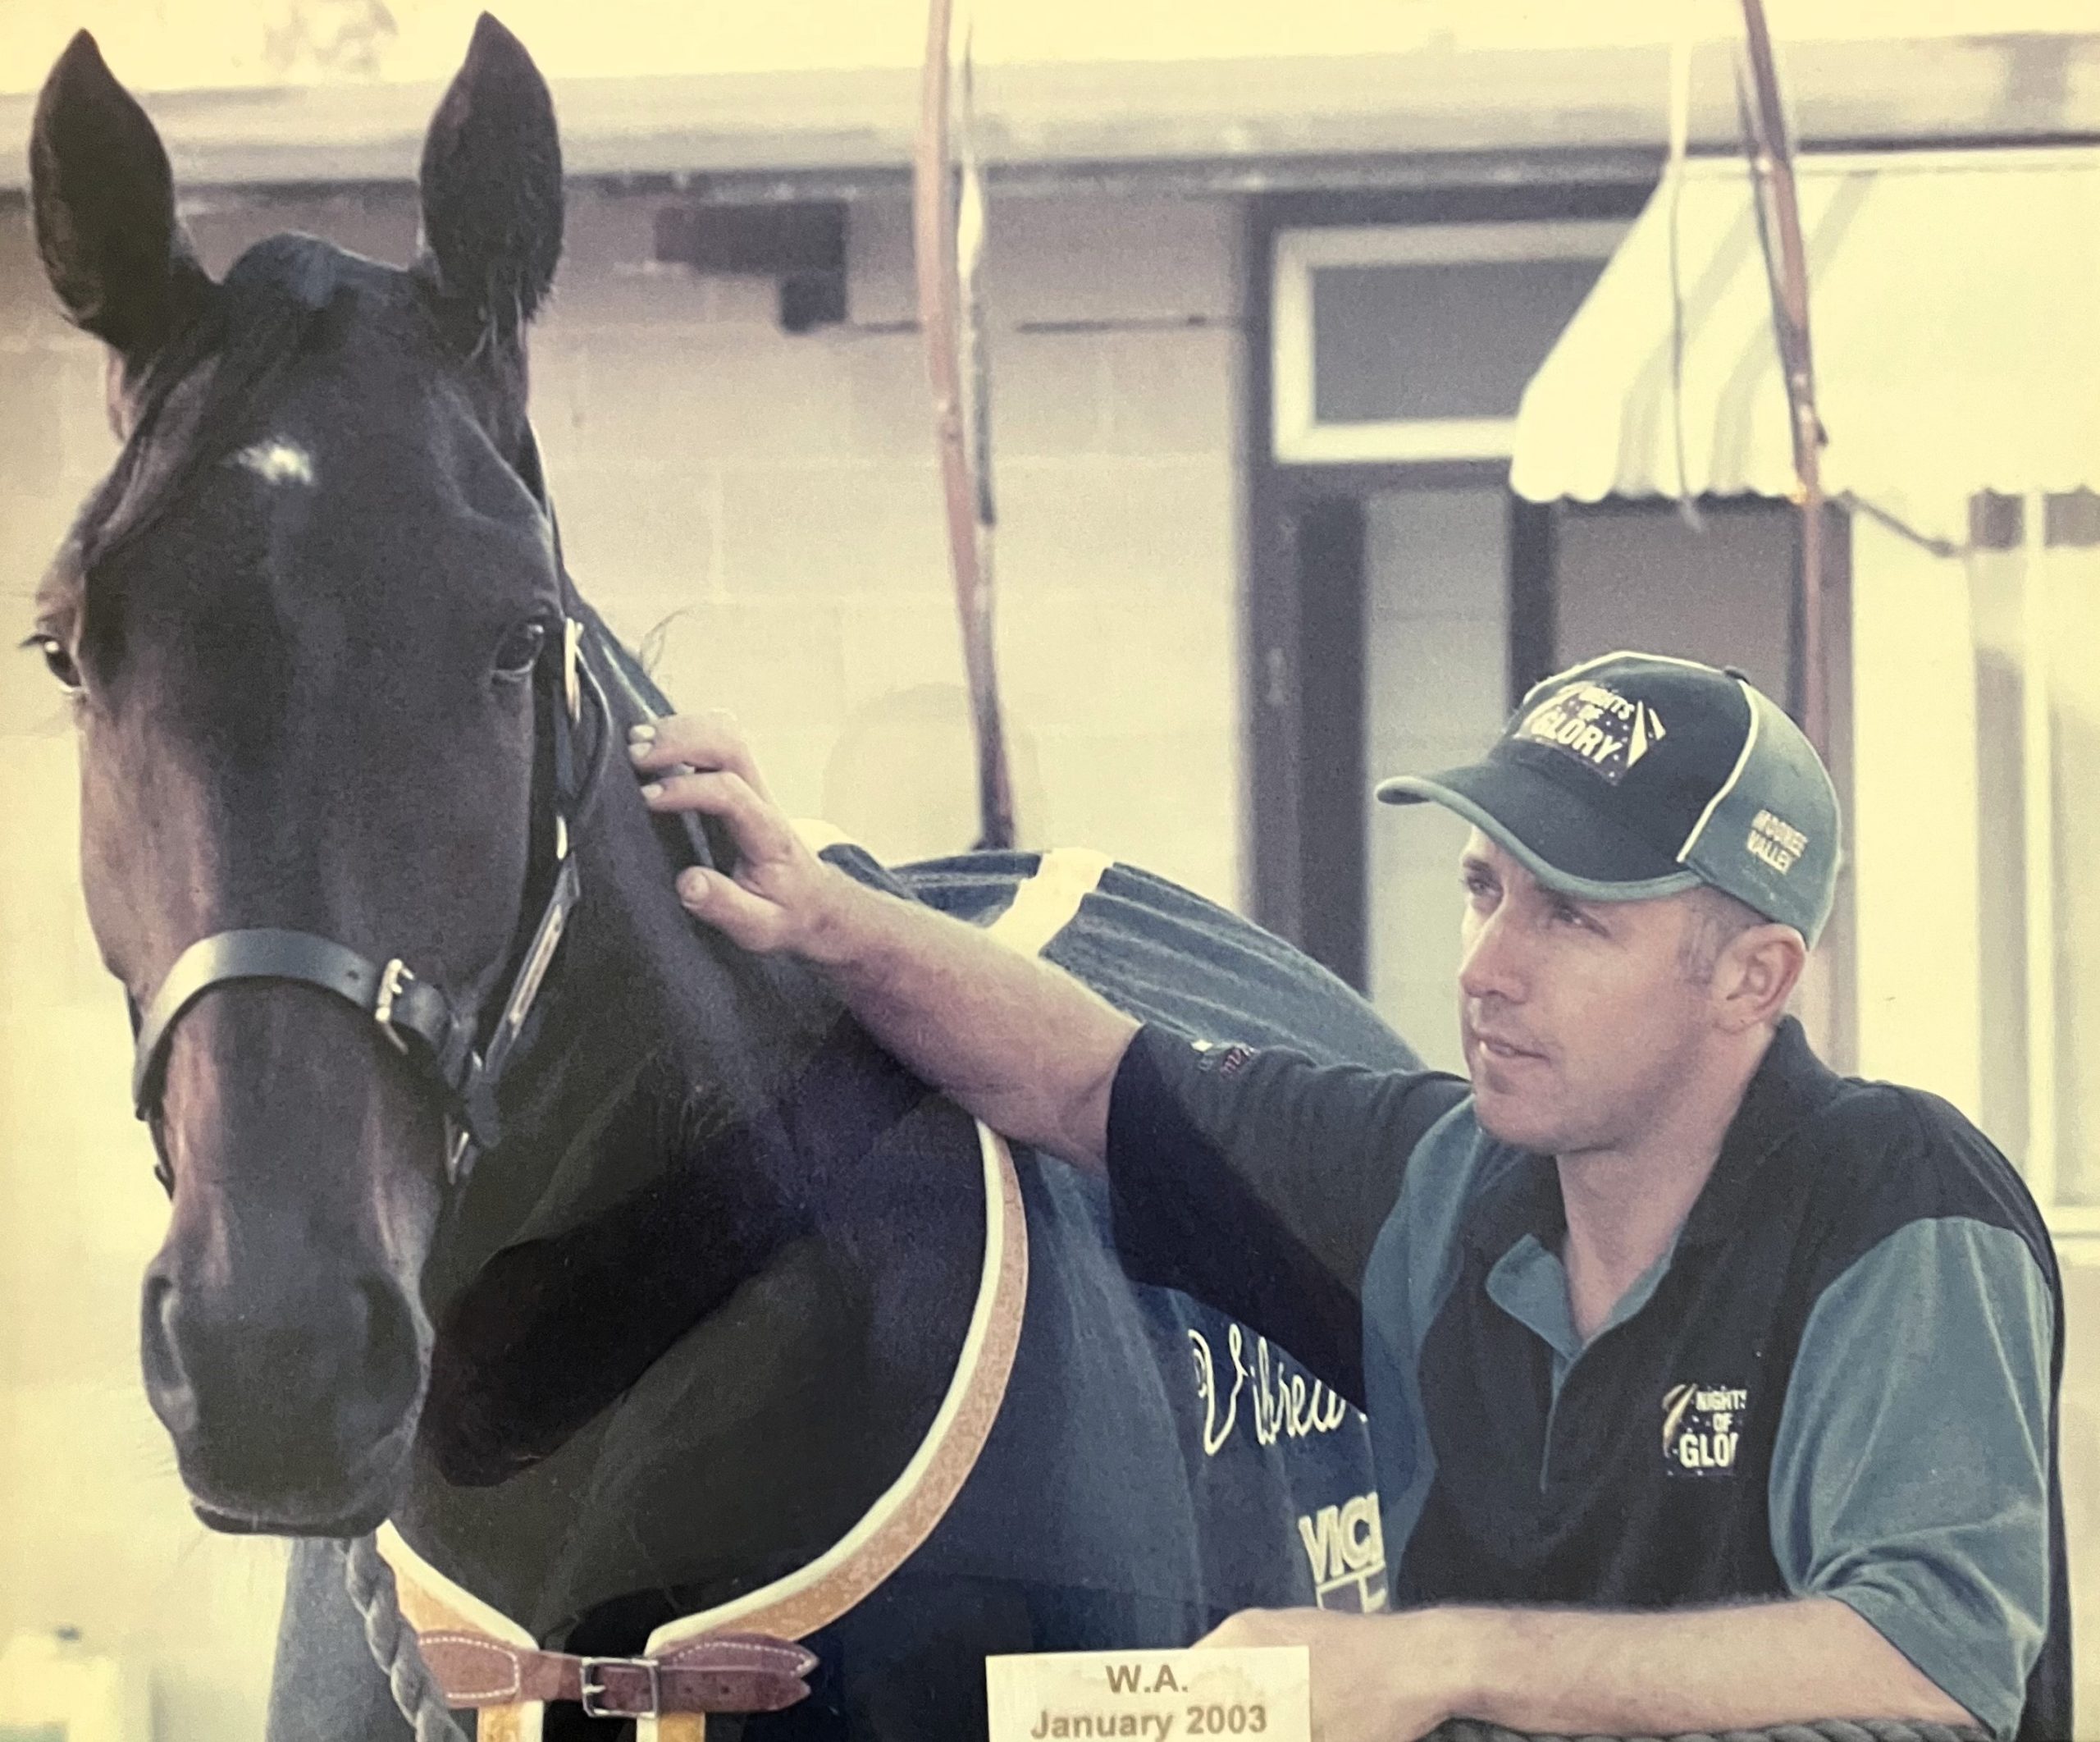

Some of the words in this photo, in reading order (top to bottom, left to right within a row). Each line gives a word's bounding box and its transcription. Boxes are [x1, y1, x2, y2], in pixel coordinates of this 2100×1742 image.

[1531, 711, 1623, 764] GLORY
[1712, 1412, 1733, 1433] OF
[1104, 1663, 1189, 1694] W.A.
[1030, 1709, 1175, 1742] January
[1185, 1703, 1268, 1735] 2003
